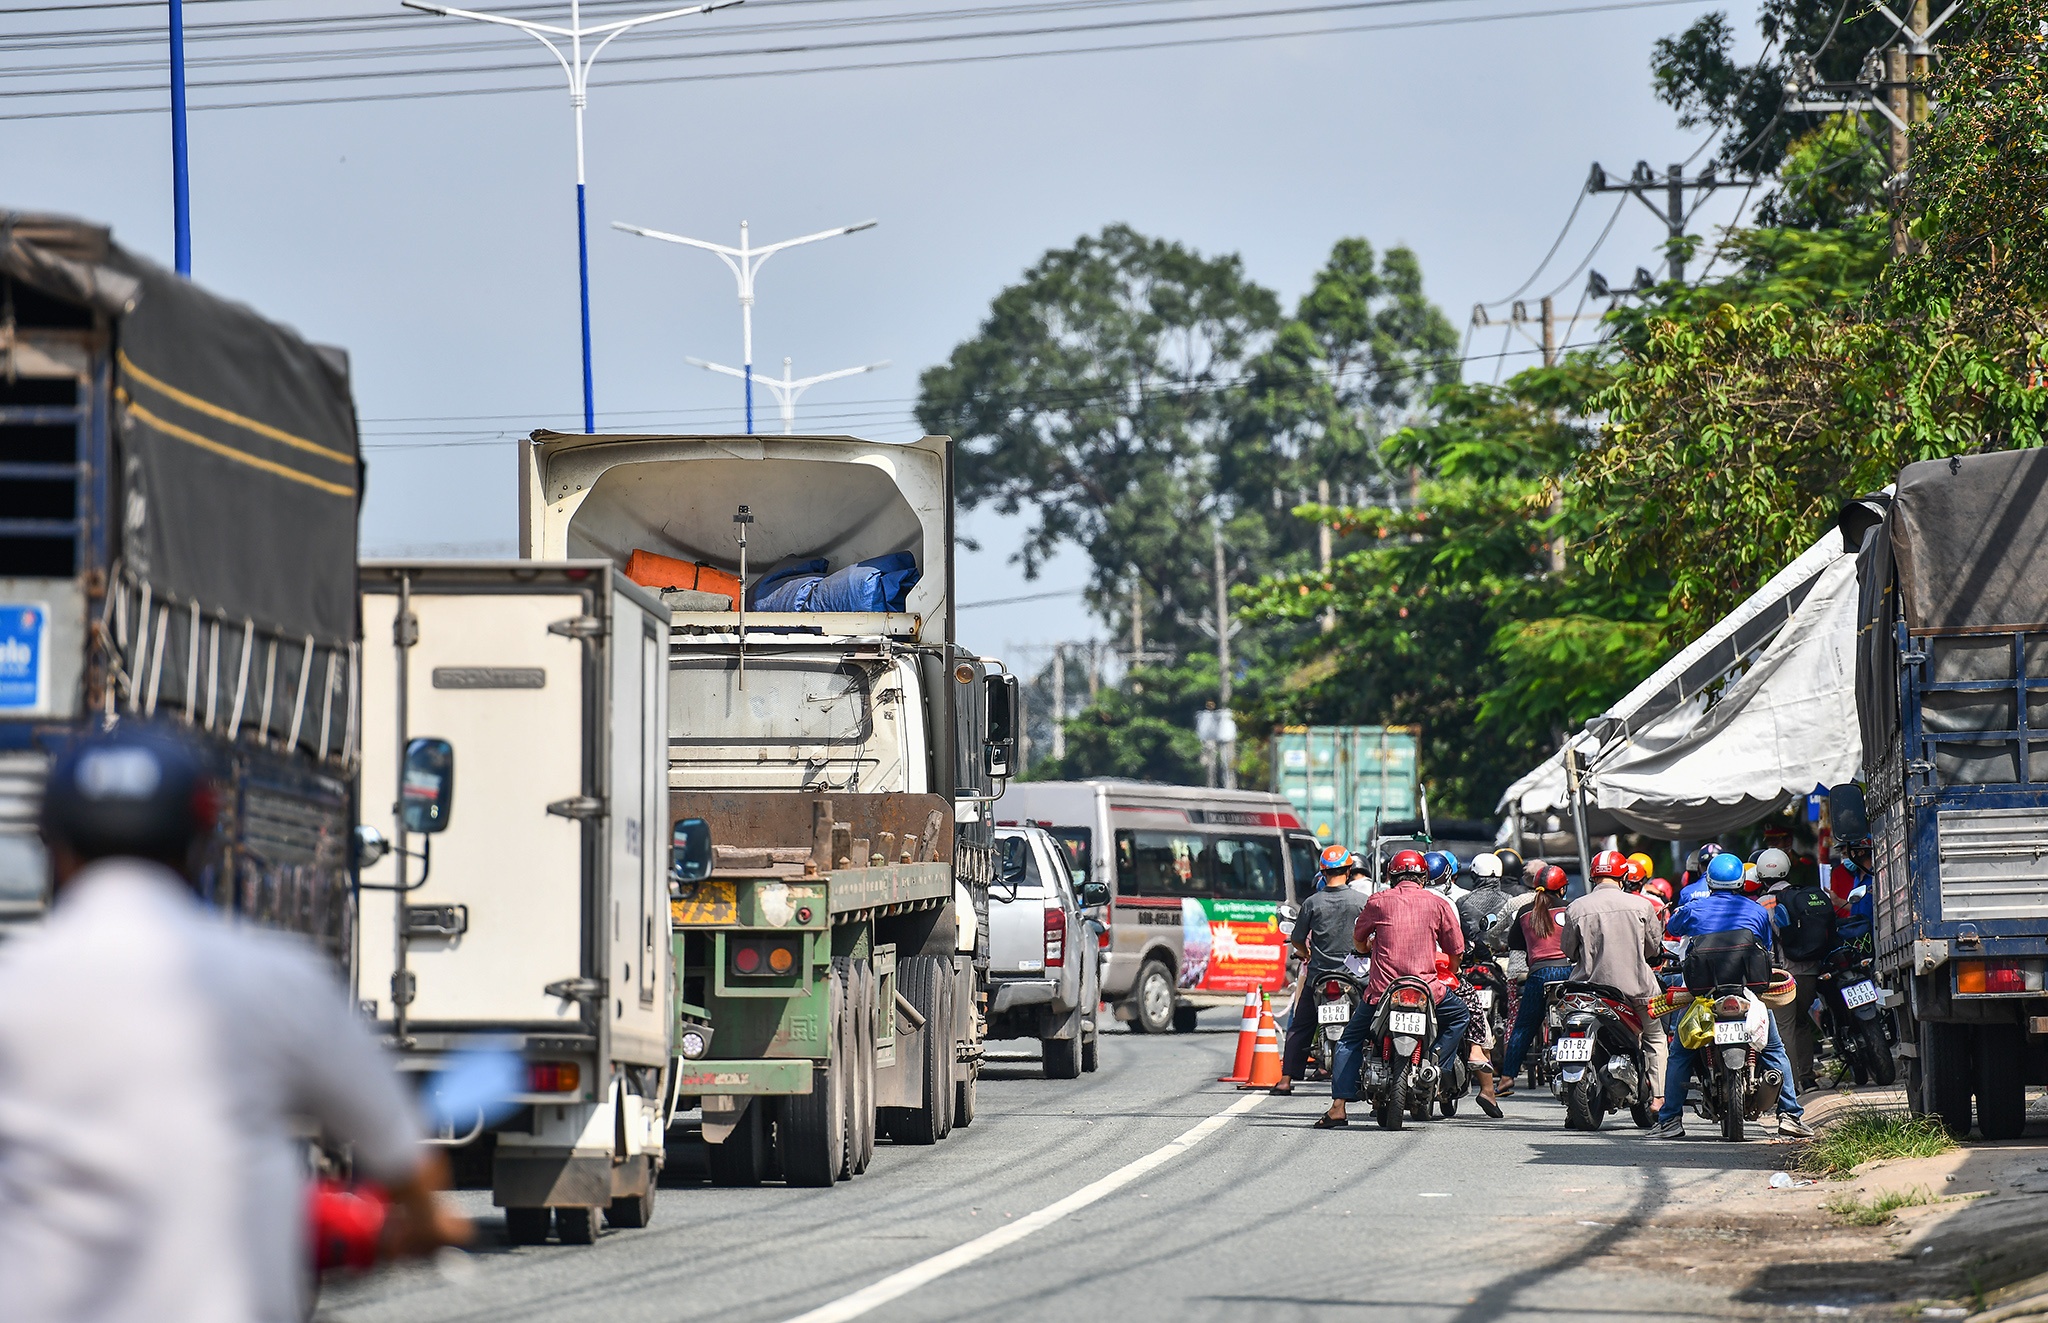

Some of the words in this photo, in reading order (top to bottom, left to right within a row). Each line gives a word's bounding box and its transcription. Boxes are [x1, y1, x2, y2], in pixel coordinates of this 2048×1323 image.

[1847, 983, 1869, 997] 61-E1
[1847, 991, 1876, 1007] 859.65
[1322, 1013, 1345, 1021] 6640
[1395, 1013, 1420, 1024] 61-L3
[1395, 1022, 1420, 1032] 2166
[1563, 1040, 1587, 1049] 61-B2
[1559, 1050, 1588, 1060] 011.31
